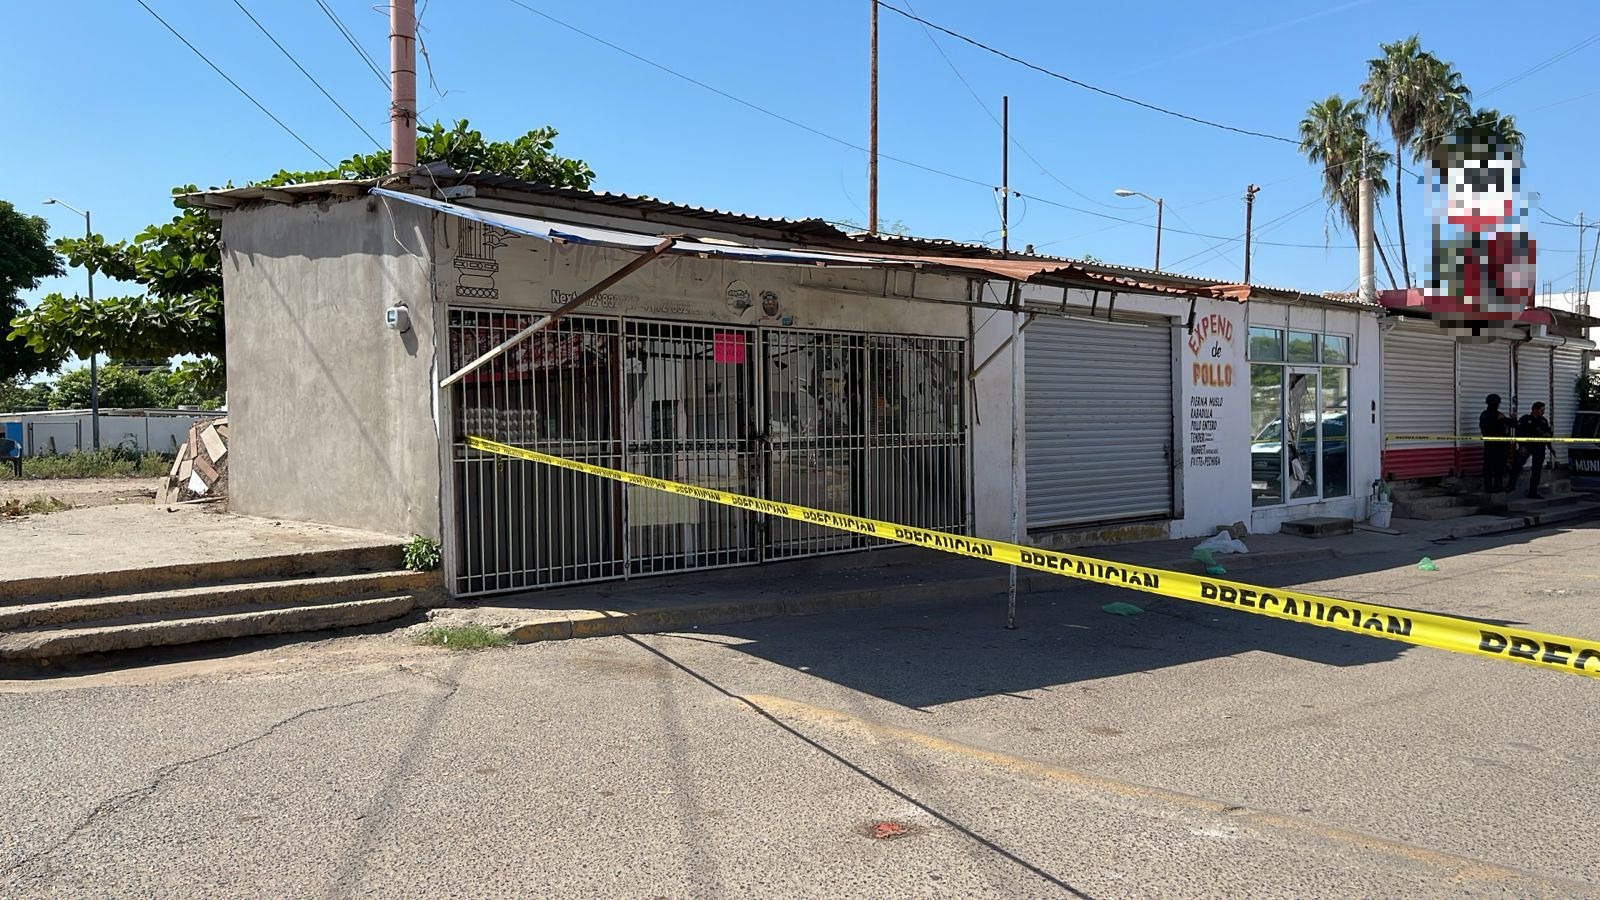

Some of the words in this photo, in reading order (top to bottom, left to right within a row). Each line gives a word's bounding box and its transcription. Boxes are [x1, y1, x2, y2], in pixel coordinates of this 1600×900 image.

[1211, 340, 1222, 358] de
[1192, 362, 1233, 387] POLLO
[1190, 396, 1207, 407] PIERNA
[1209, 396, 1224, 407] MUSLO
[1190, 420, 1201, 431] POLLO
[1202, 420, 1217, 431] ENTERO
